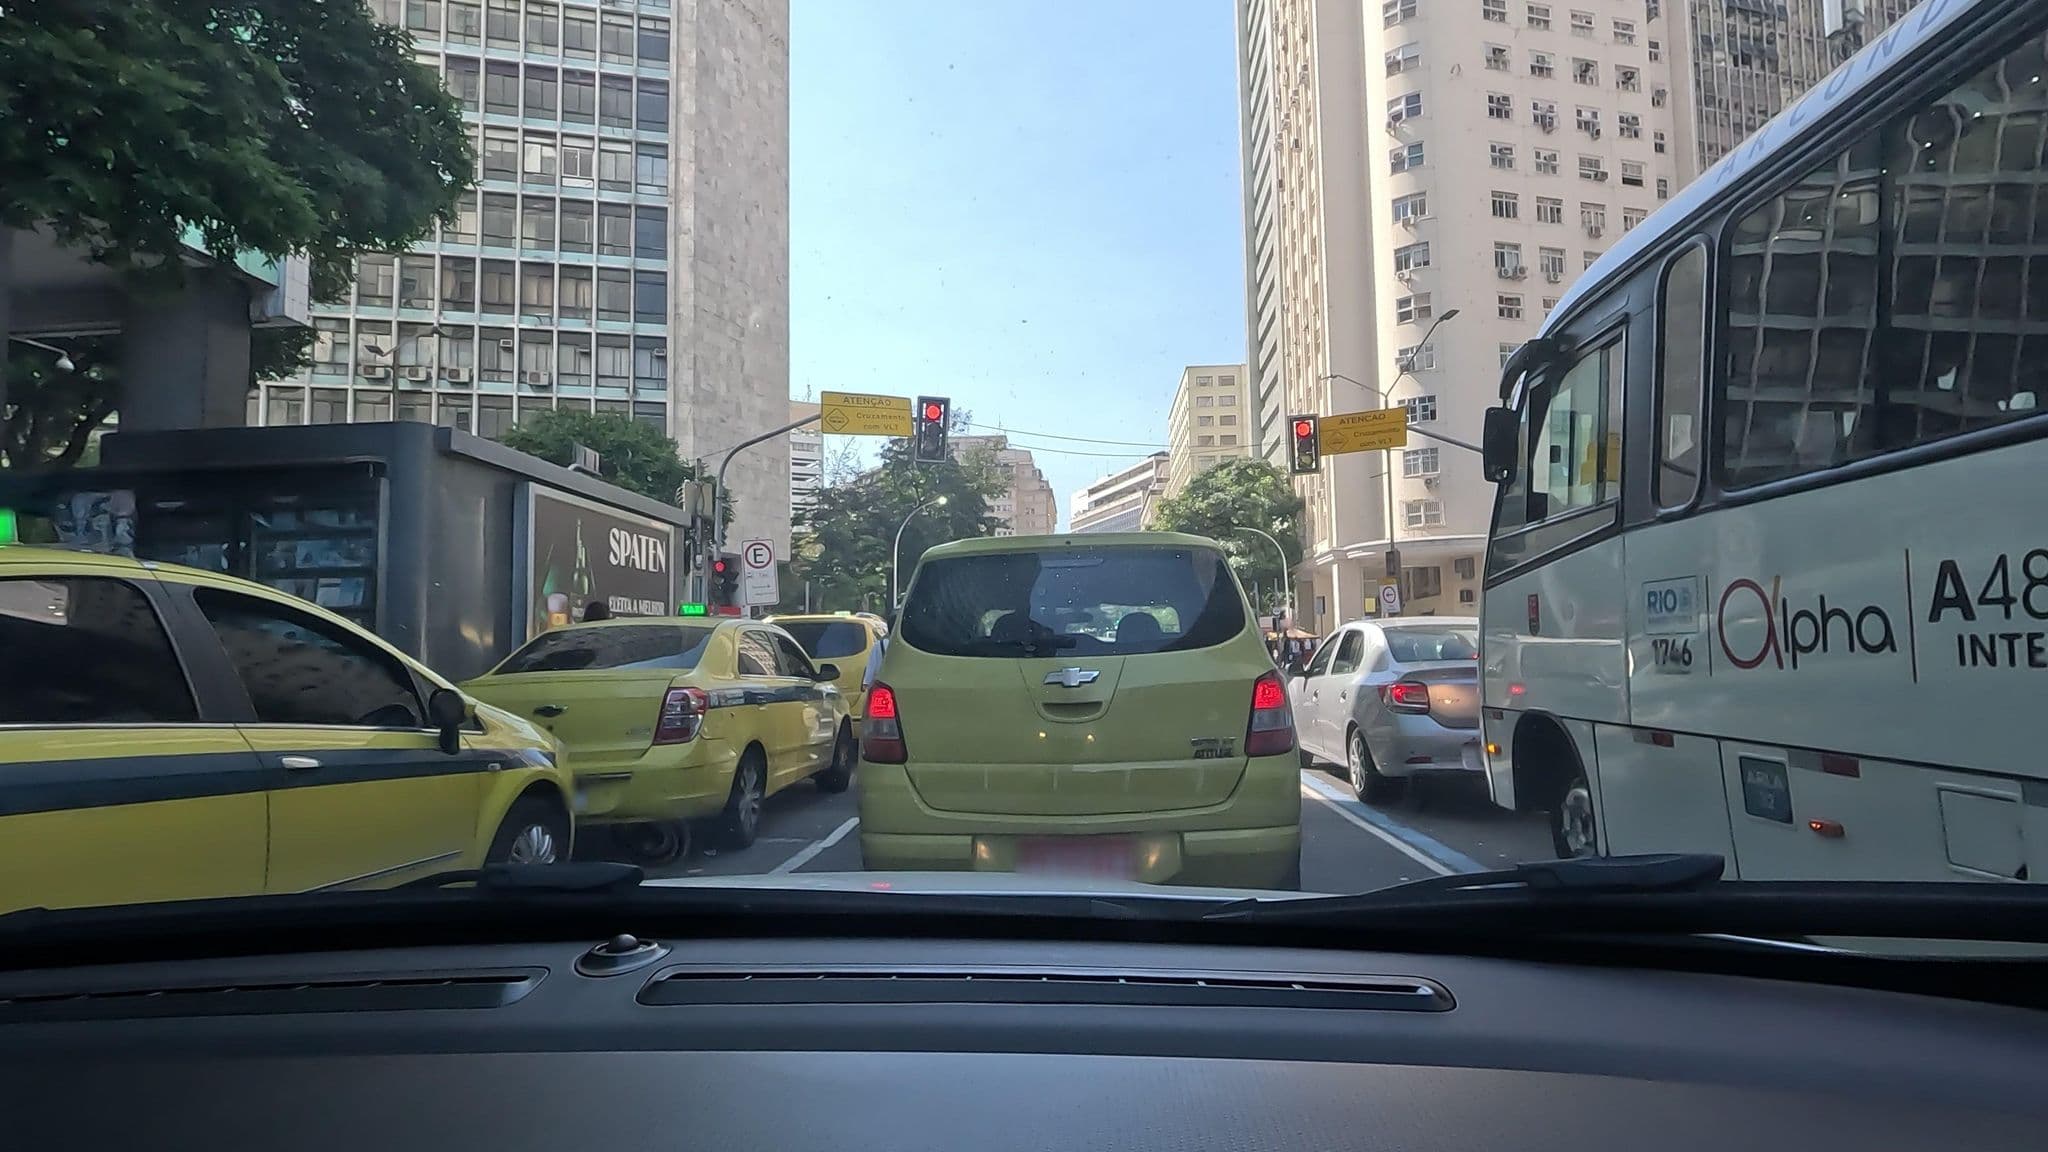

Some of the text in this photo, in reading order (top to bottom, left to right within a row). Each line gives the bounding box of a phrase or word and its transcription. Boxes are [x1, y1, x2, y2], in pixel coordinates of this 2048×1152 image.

[608, 527, 666, 574] SPATEN
[753, 547, 765, 564] E
[1647, 588, 1678, 614] RIO
